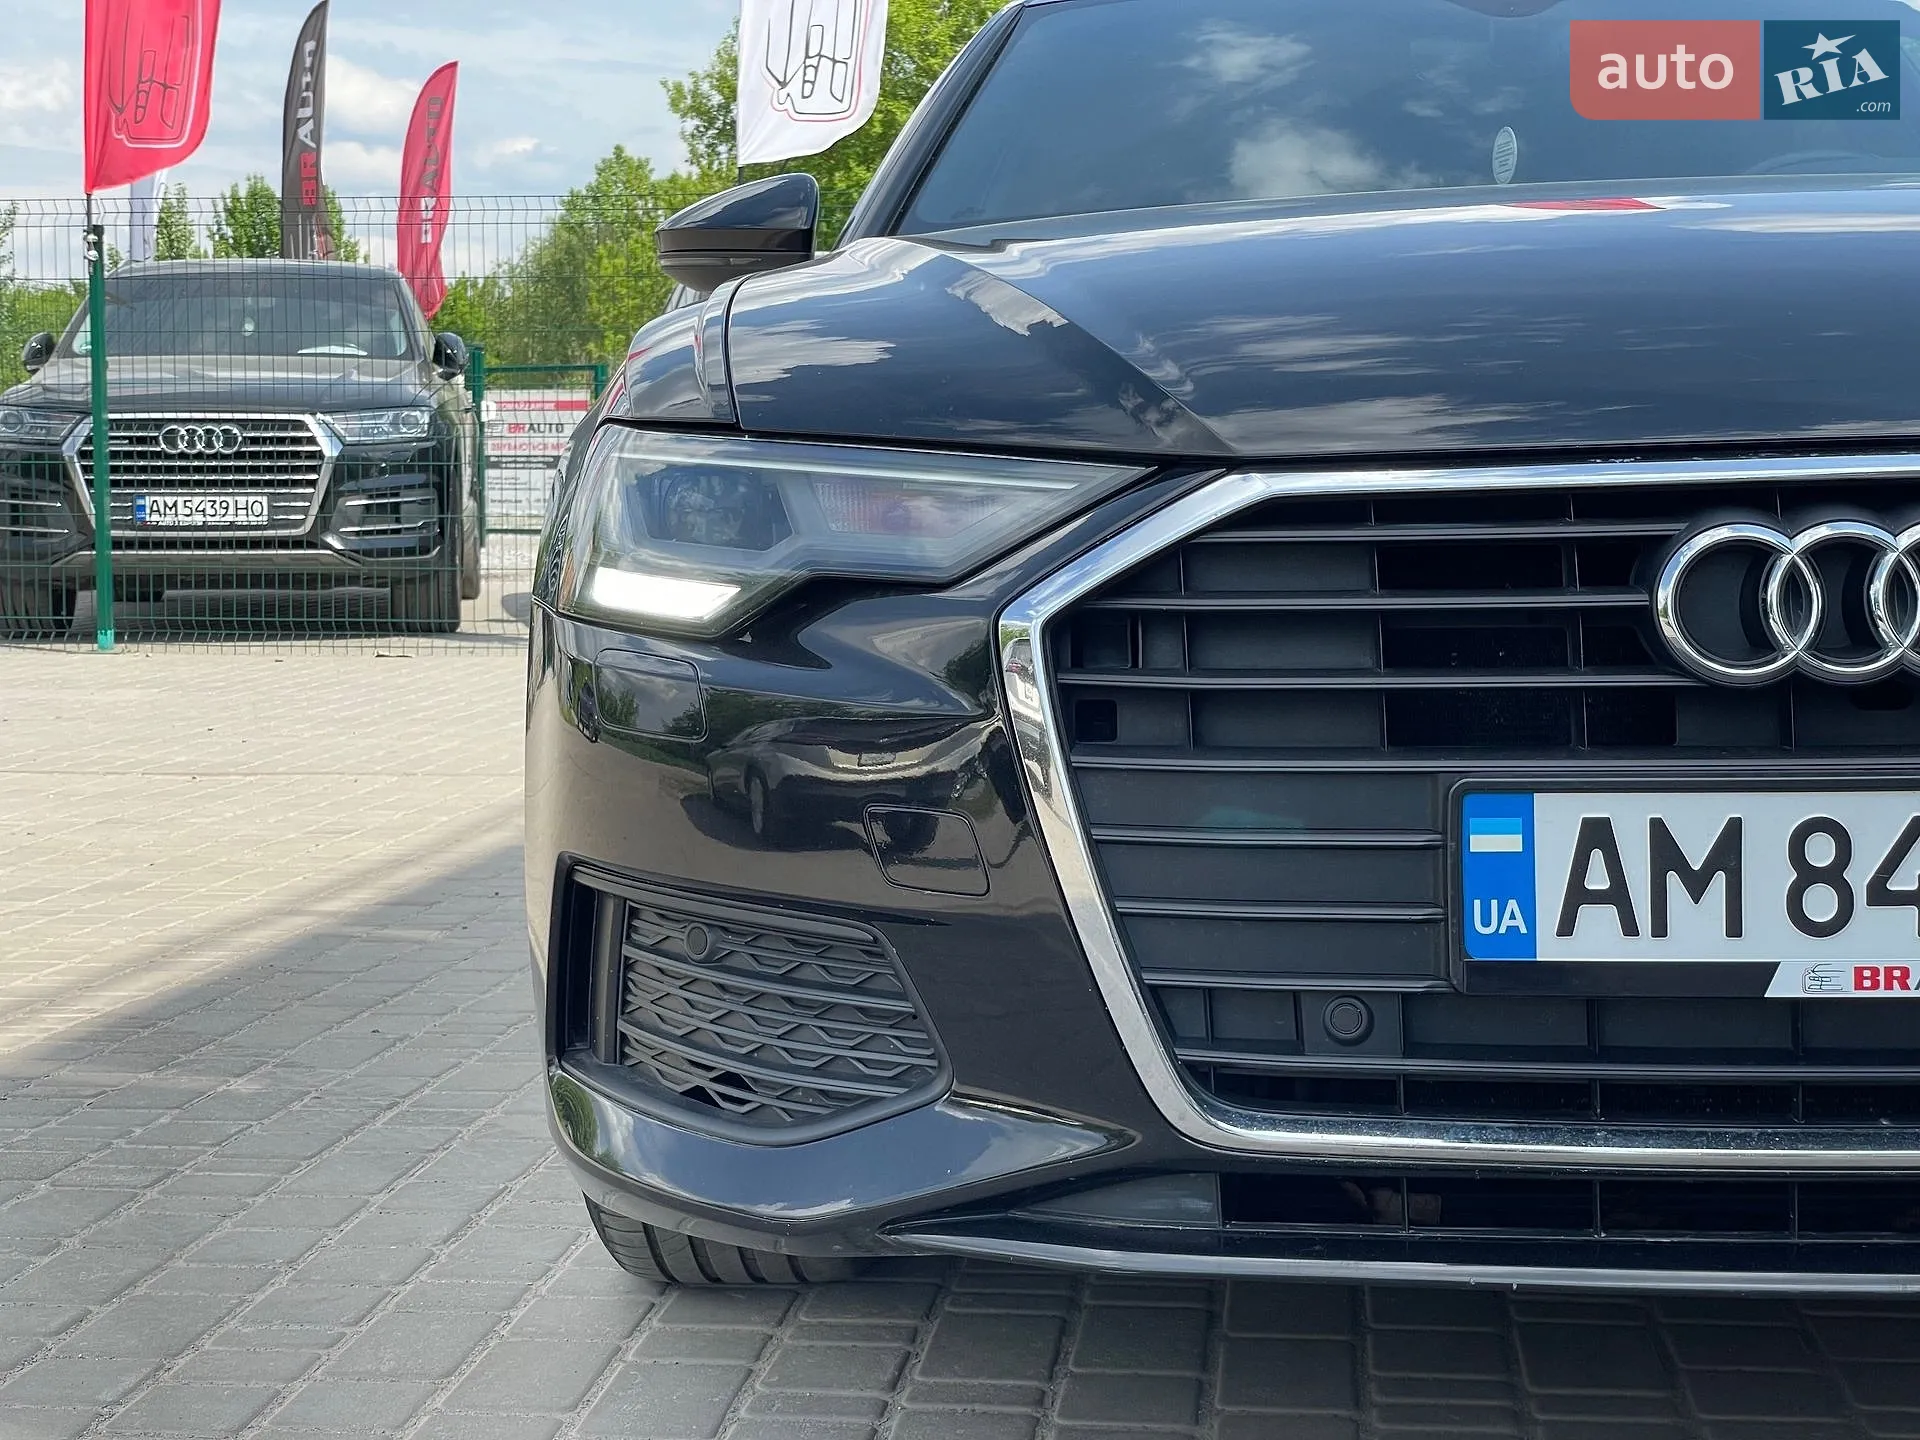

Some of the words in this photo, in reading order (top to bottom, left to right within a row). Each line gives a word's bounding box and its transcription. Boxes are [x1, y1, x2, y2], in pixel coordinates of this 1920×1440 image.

[150, 499, 178, 518] AM
[183, 499, 230, 518] 5439
[235, 499, 264, 518] HO
[1555, 815, 1744, 939] AM
[1785, 814, 1920, 939] 84
[1473, 899, 1528, 935] UA
[1853, 965, 1920, 991] BR
